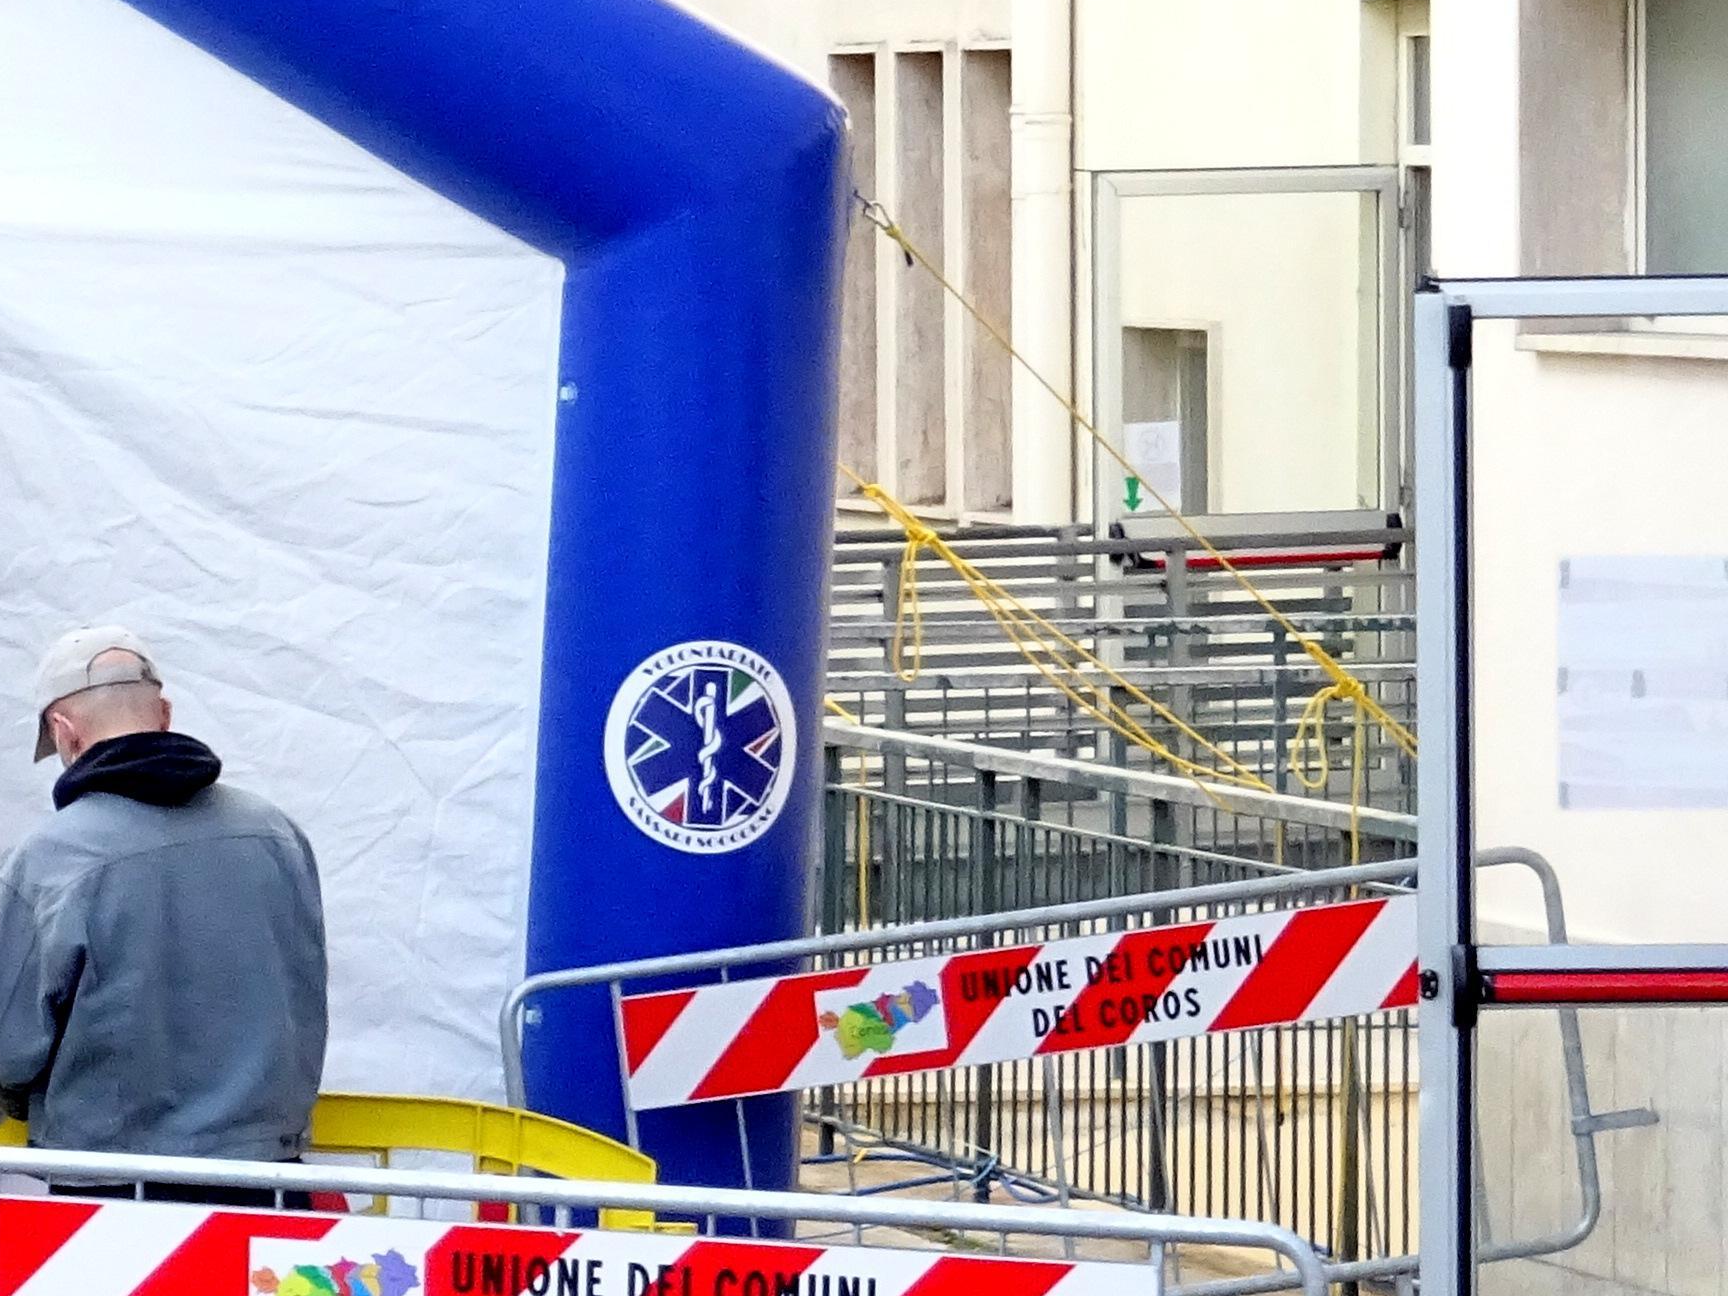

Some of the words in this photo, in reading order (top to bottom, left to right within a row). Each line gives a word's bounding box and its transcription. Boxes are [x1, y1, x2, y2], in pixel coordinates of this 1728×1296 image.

[960, 959, 1072, 1002] UNIONE
[1084, 950, 1132, 986] DEI
[1146, 933, 1266, 977] COMUNI
[1032, 1001, 1085, 1038] DEL
[1097, 987, 1202, 1029] COROS
